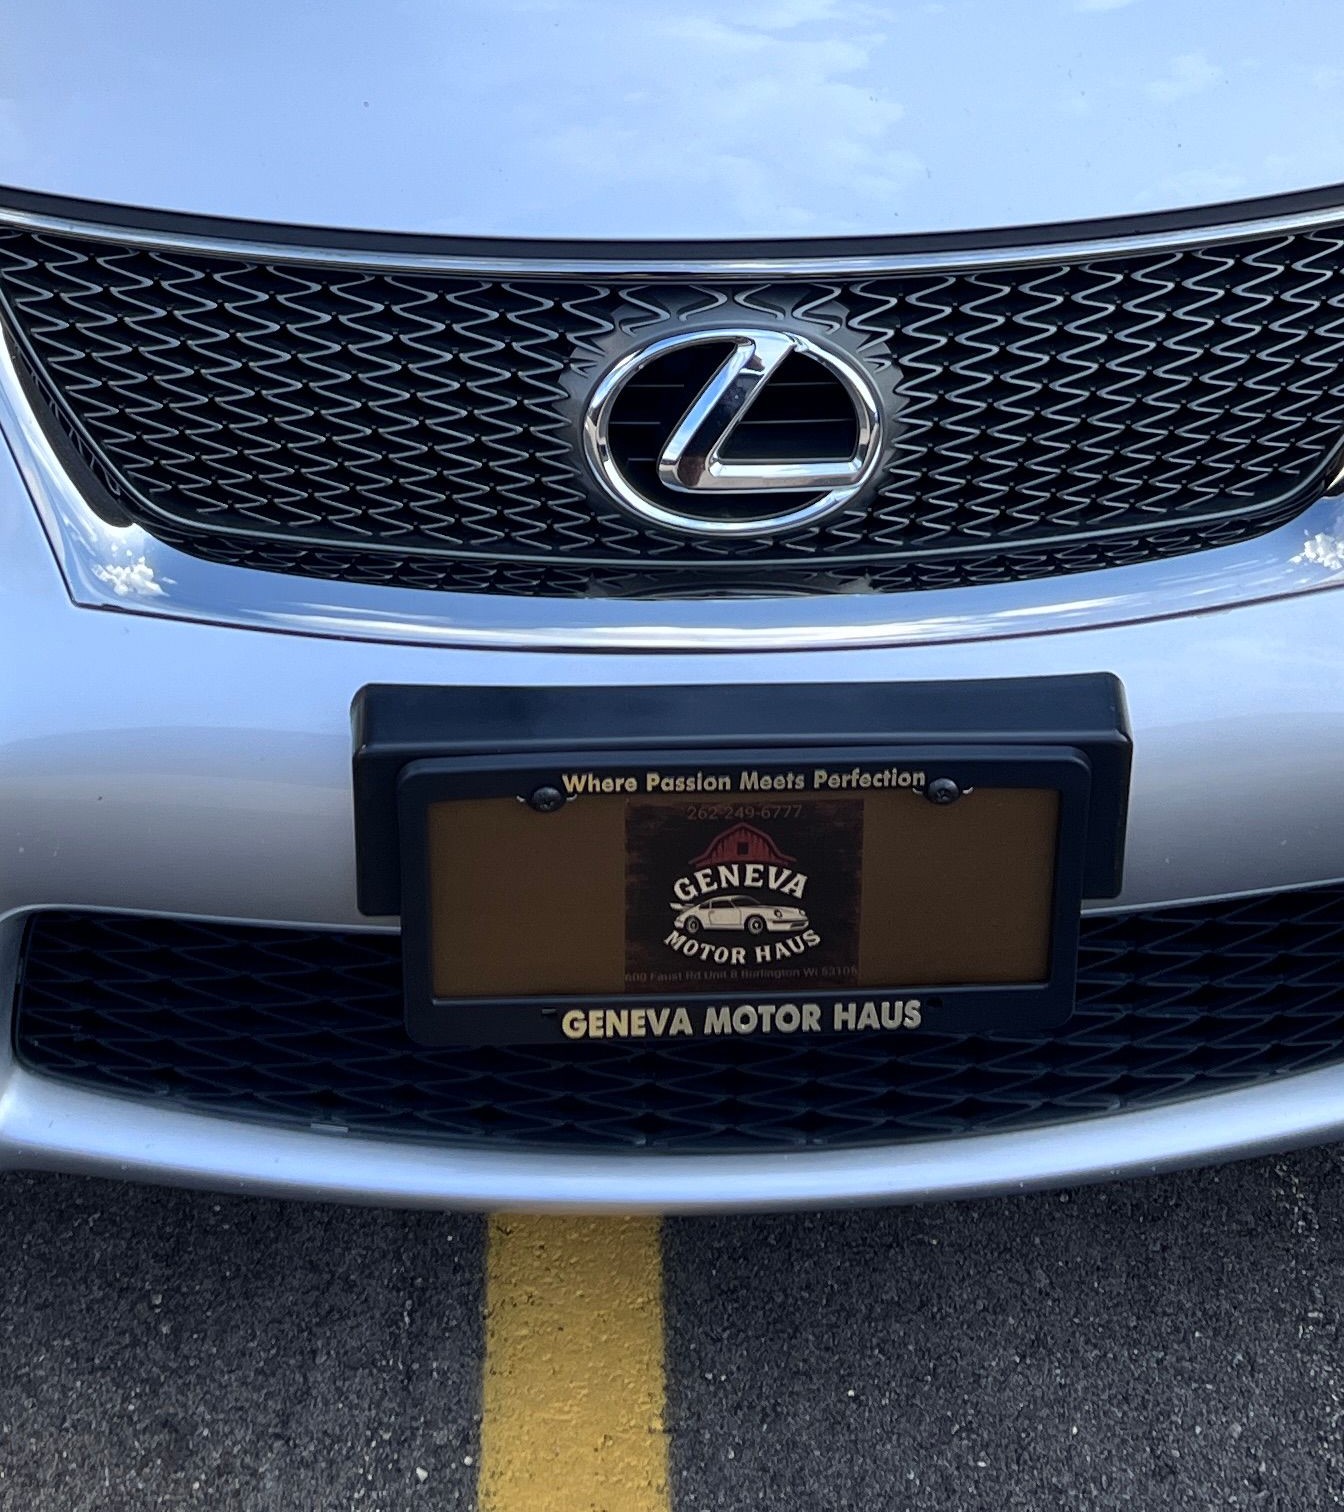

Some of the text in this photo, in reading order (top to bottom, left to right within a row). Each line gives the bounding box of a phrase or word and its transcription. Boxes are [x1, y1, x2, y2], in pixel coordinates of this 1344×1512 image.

[562, 767, 926, 793] Where Passion Meets Perfection
[687, 804, 802, 820] 262-249-6777
[673, 863, 808, 901] GENEVA
[663, 929, 822, 965] MOTOR HAUS
[704, 969, 727, 980] Unit
[561, 999, 921, 1039] GENEVA MOTOR HAUS
